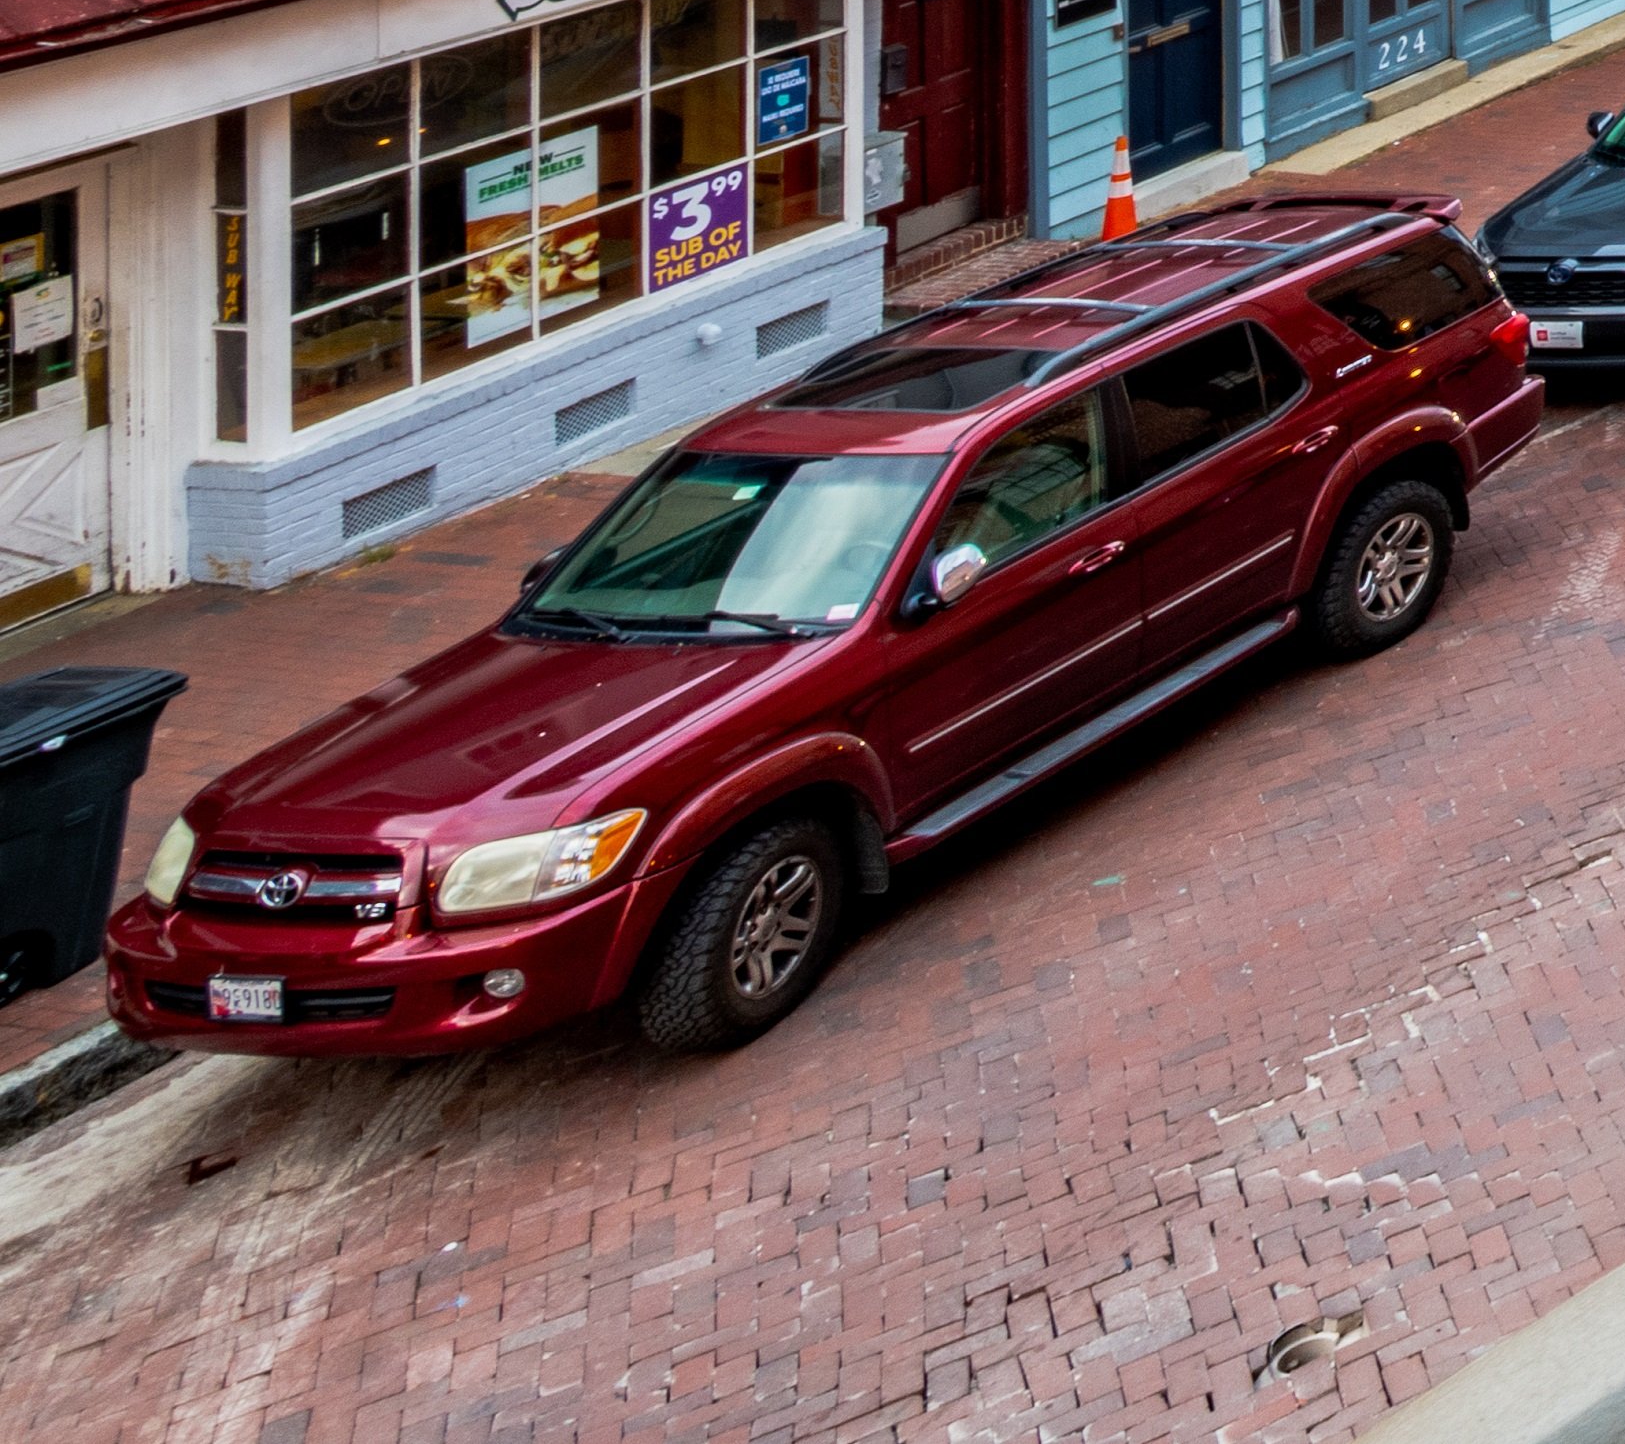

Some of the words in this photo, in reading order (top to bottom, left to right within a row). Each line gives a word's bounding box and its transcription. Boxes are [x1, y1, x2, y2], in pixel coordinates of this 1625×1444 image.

[1378, 28, 1427, 71] 224
[478, 174, 529, 199] FRESH
[539, 153, 585, 177] MELTS
[653, 257, 697, 286] THE
[701, 240, 742, 269] DAY
[655, 236, 704, 268] SUB
[709, 220, 742, 246] OF
